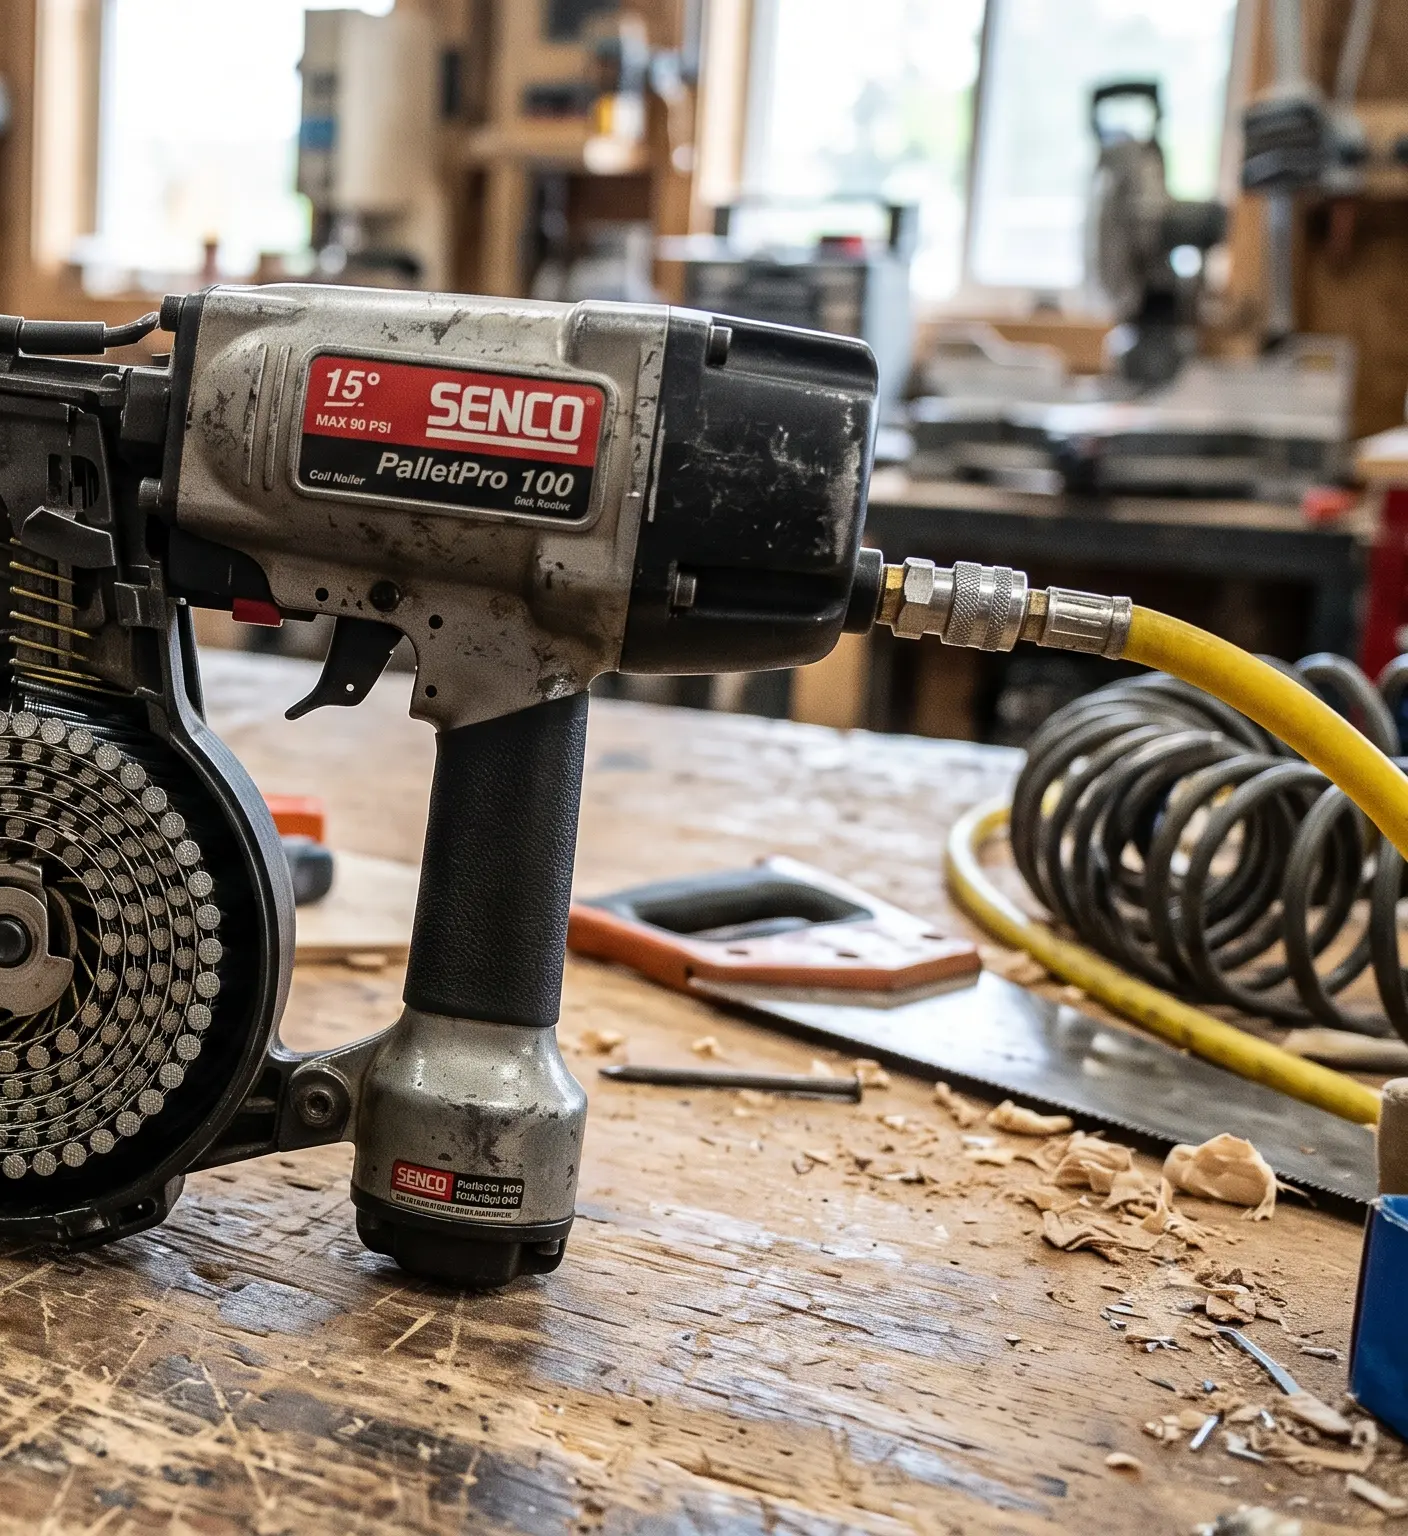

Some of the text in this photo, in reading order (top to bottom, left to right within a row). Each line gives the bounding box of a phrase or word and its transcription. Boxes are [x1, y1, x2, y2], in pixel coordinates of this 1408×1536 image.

[326, 368, 380, 399] 15°
[315, 413, 392, 434] MAX 90 PSI
[309, 469, 366, 485] Coil Nailer
[376, 451, 575, 497] PalletPro 100
[396, 1166, 447, 1193] SENCO
